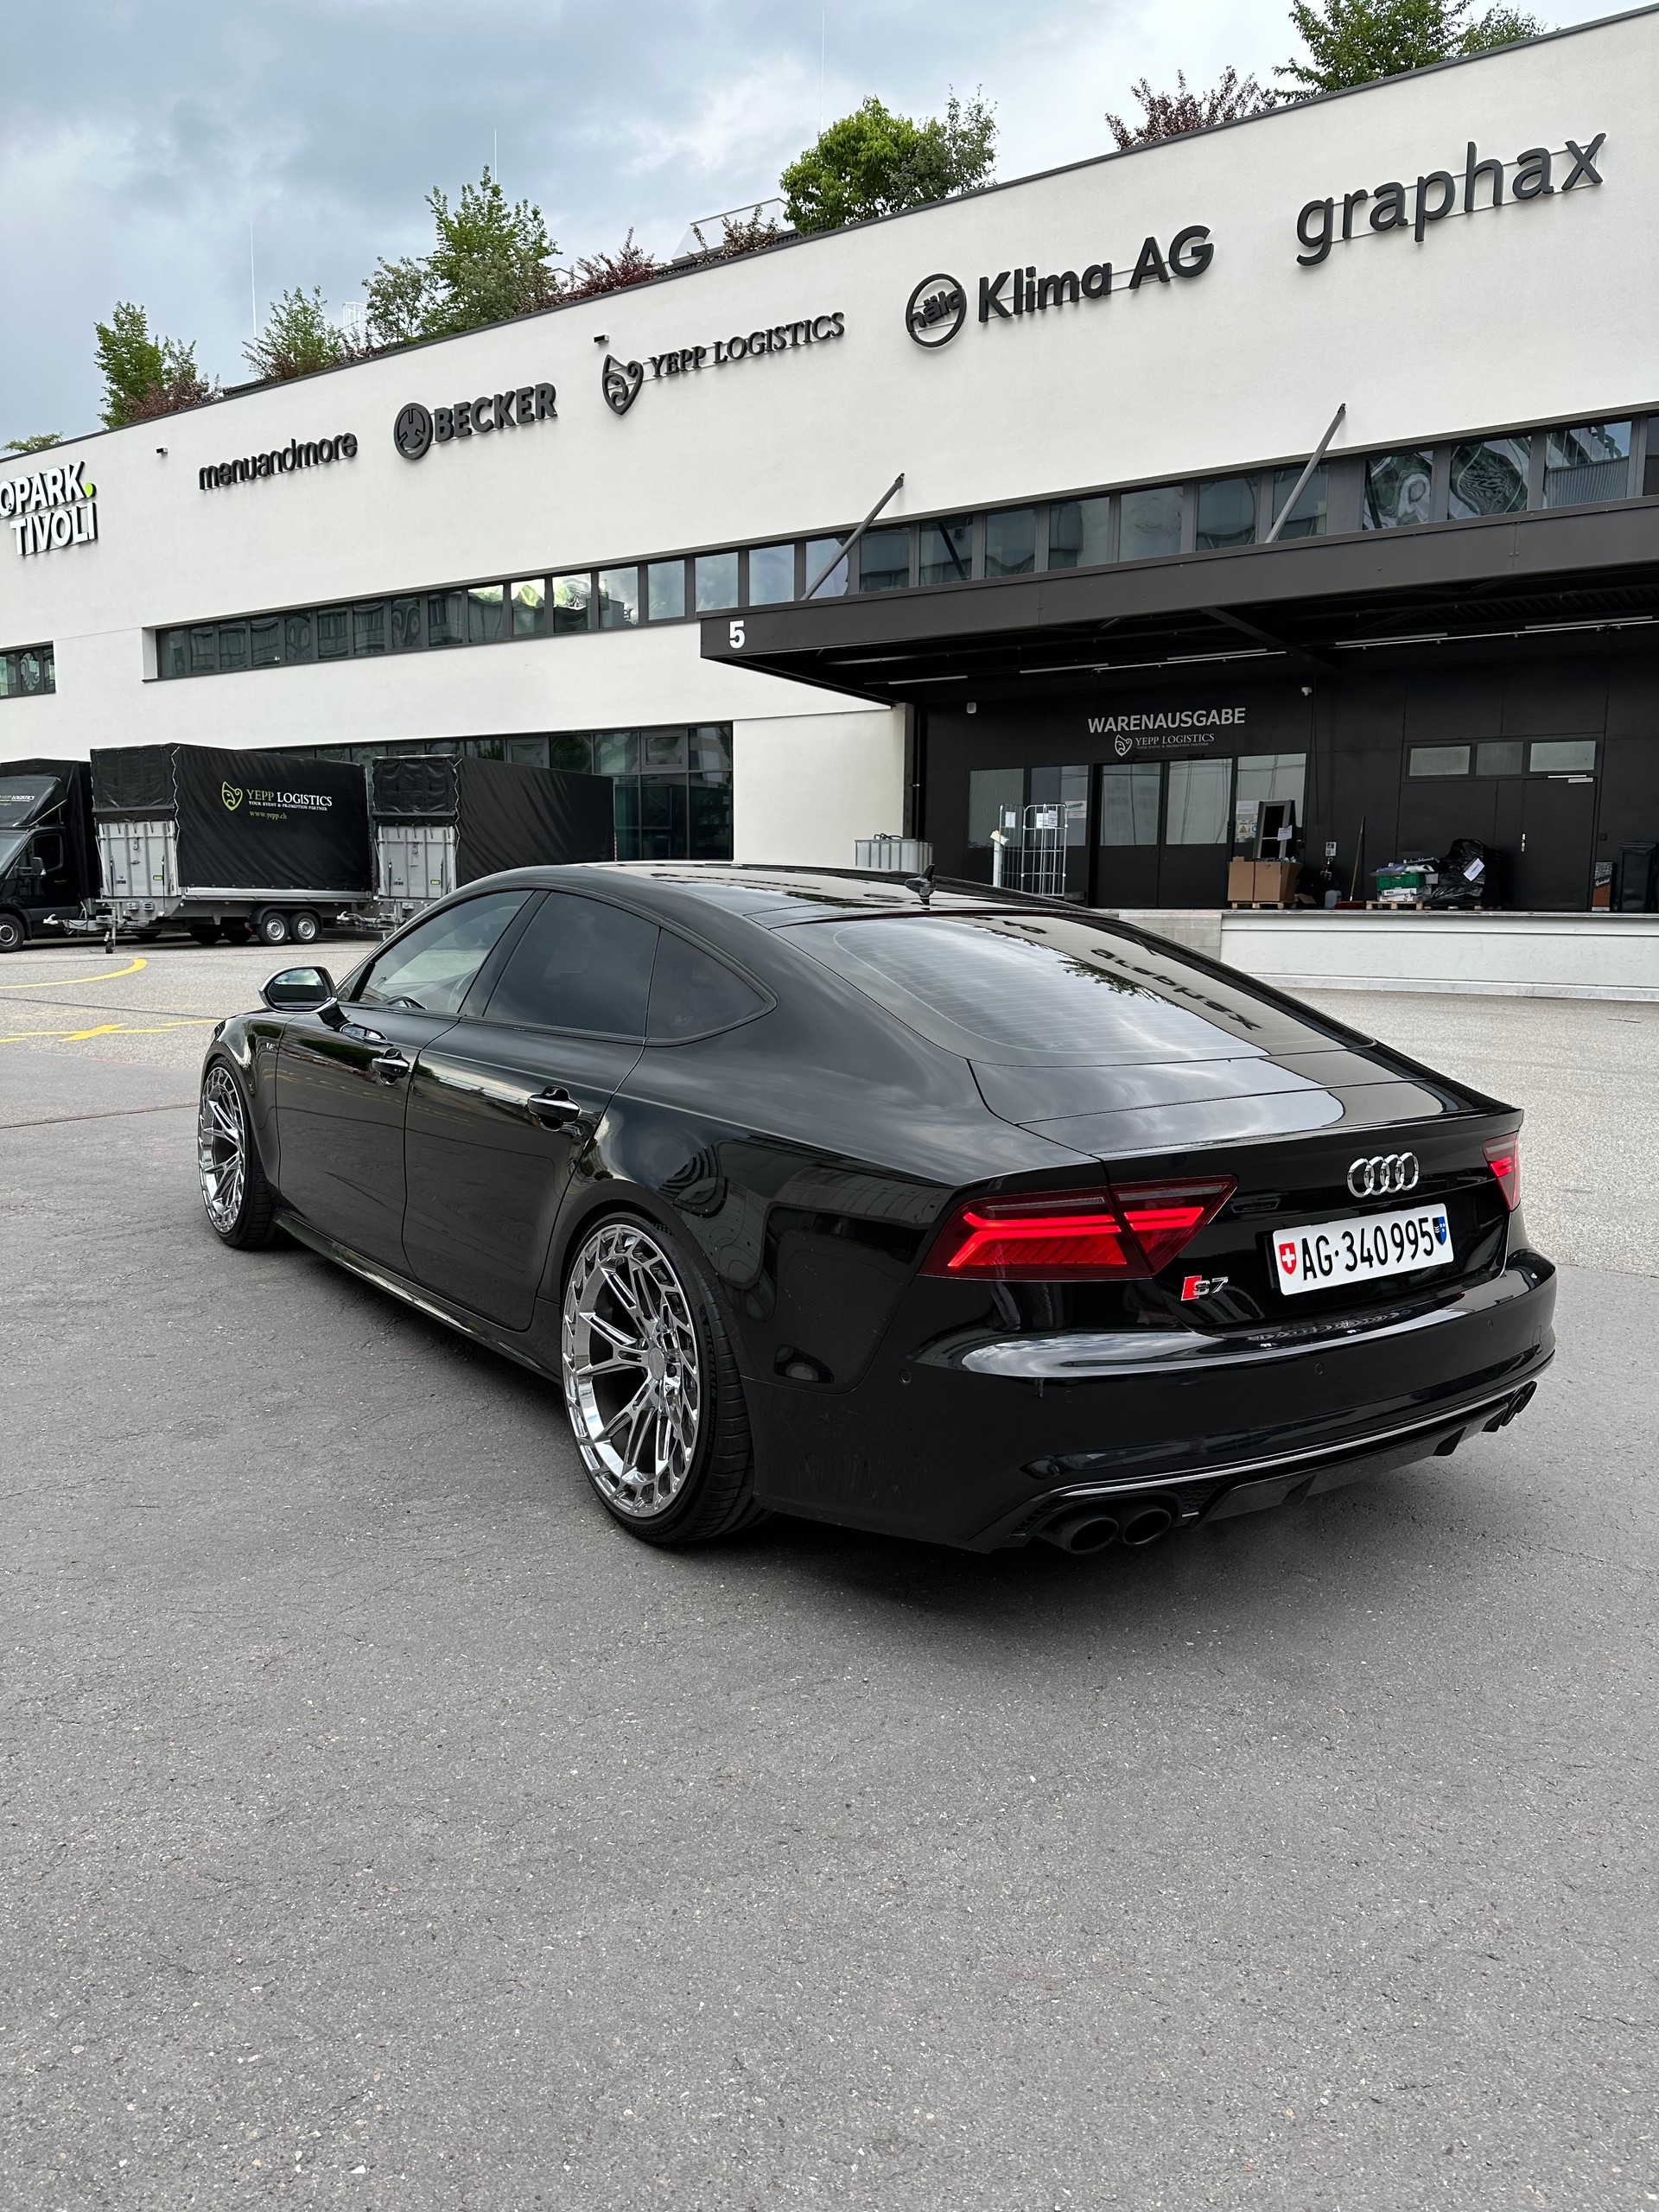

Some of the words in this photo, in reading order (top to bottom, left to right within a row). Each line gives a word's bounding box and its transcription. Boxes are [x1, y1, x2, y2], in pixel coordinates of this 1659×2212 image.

[1295, 132, 1607, 267] graphax
[978, 262, 1113, 323] Klima
[1128, 225, 1214, 289] AG
[648, 345, 707, 378] YEPP
[712, 311, 845, 364] LOGISTICS
[434, 382, 558, 442] BECKER
[199, 432, 359, 491] menuandmore
[10, 501, 98, 556] TIVOLI
[729, 620, 746, 649] 5
[1087, 707, 1246, 734] WARENAUSGABE
[1135, 735, 1159, 746] YEPP
[1162, 733, 1215, 744] LOGISTICS
[246, 789, 275, 802] YEPP
[276, 791, 333, 807] LOGISTICS
[249, 810, 288, 821] www.yepp.ch
[1192, 1276, 1230, 1296] S7
[704, 1325, 717, 1399] MICHELIN
